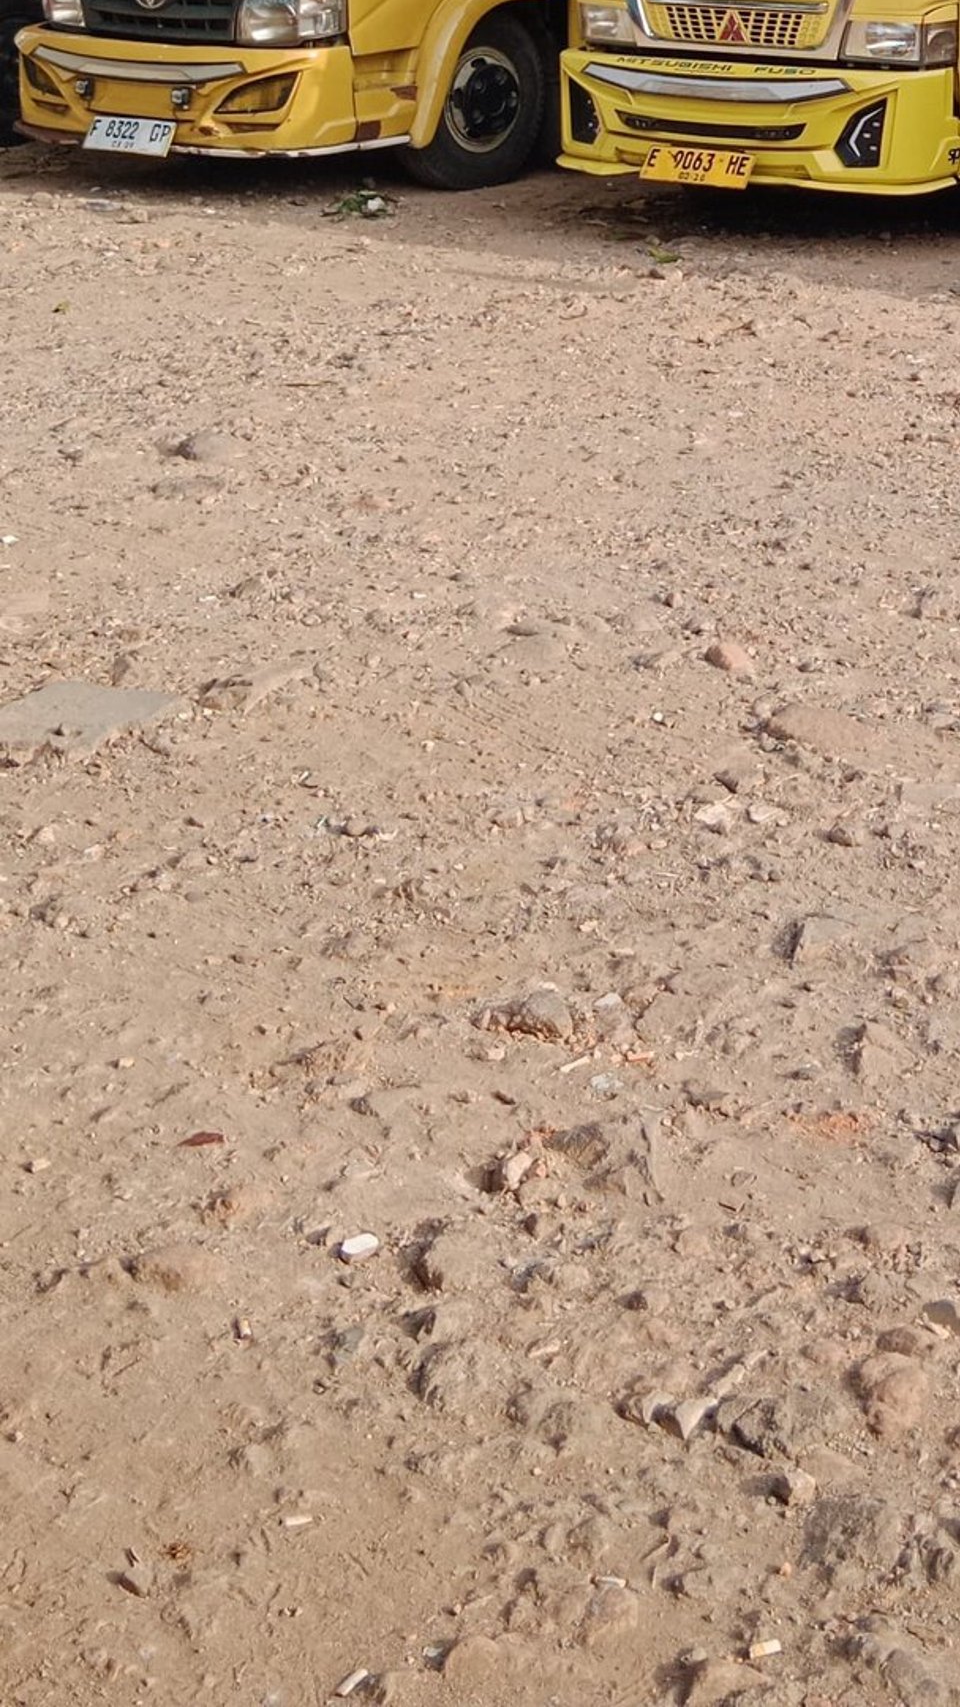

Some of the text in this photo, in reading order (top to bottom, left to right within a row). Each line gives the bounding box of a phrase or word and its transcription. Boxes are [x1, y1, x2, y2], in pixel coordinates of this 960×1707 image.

[616, 56, 816, 75] MITSUBISHI FUSO
[90, 119, 101, 136] F
[105, 120, 140, 140] 8322
[647, 149, 750, 176] E 9063 HE
